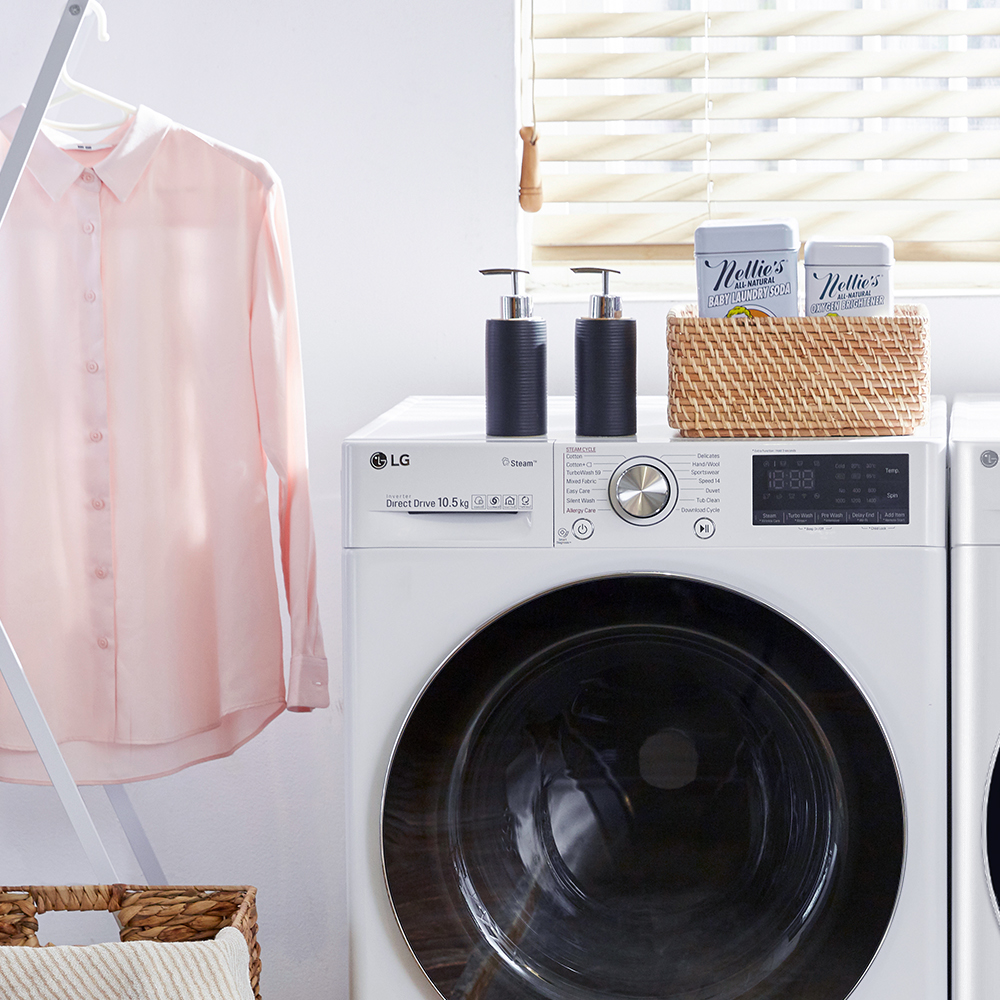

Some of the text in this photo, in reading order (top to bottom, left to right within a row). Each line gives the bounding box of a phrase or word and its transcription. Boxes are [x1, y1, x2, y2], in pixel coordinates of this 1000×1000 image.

[704, 259, 785, 291] Nellie's
[813, 272, 881, 300] Nellie's
[708, 282, 791, 308] BABY LAUNDRY SODA
[810, 295, 885, 314] OXYGEN BRIGHTENER
[391, 454, 410, 466] LG
[386, 499, 412, 508] Direct
[413, 499, 436, 508] Drive
[438, 497, 458, 508] 10.5
[459, 499, 469, 509] kg
